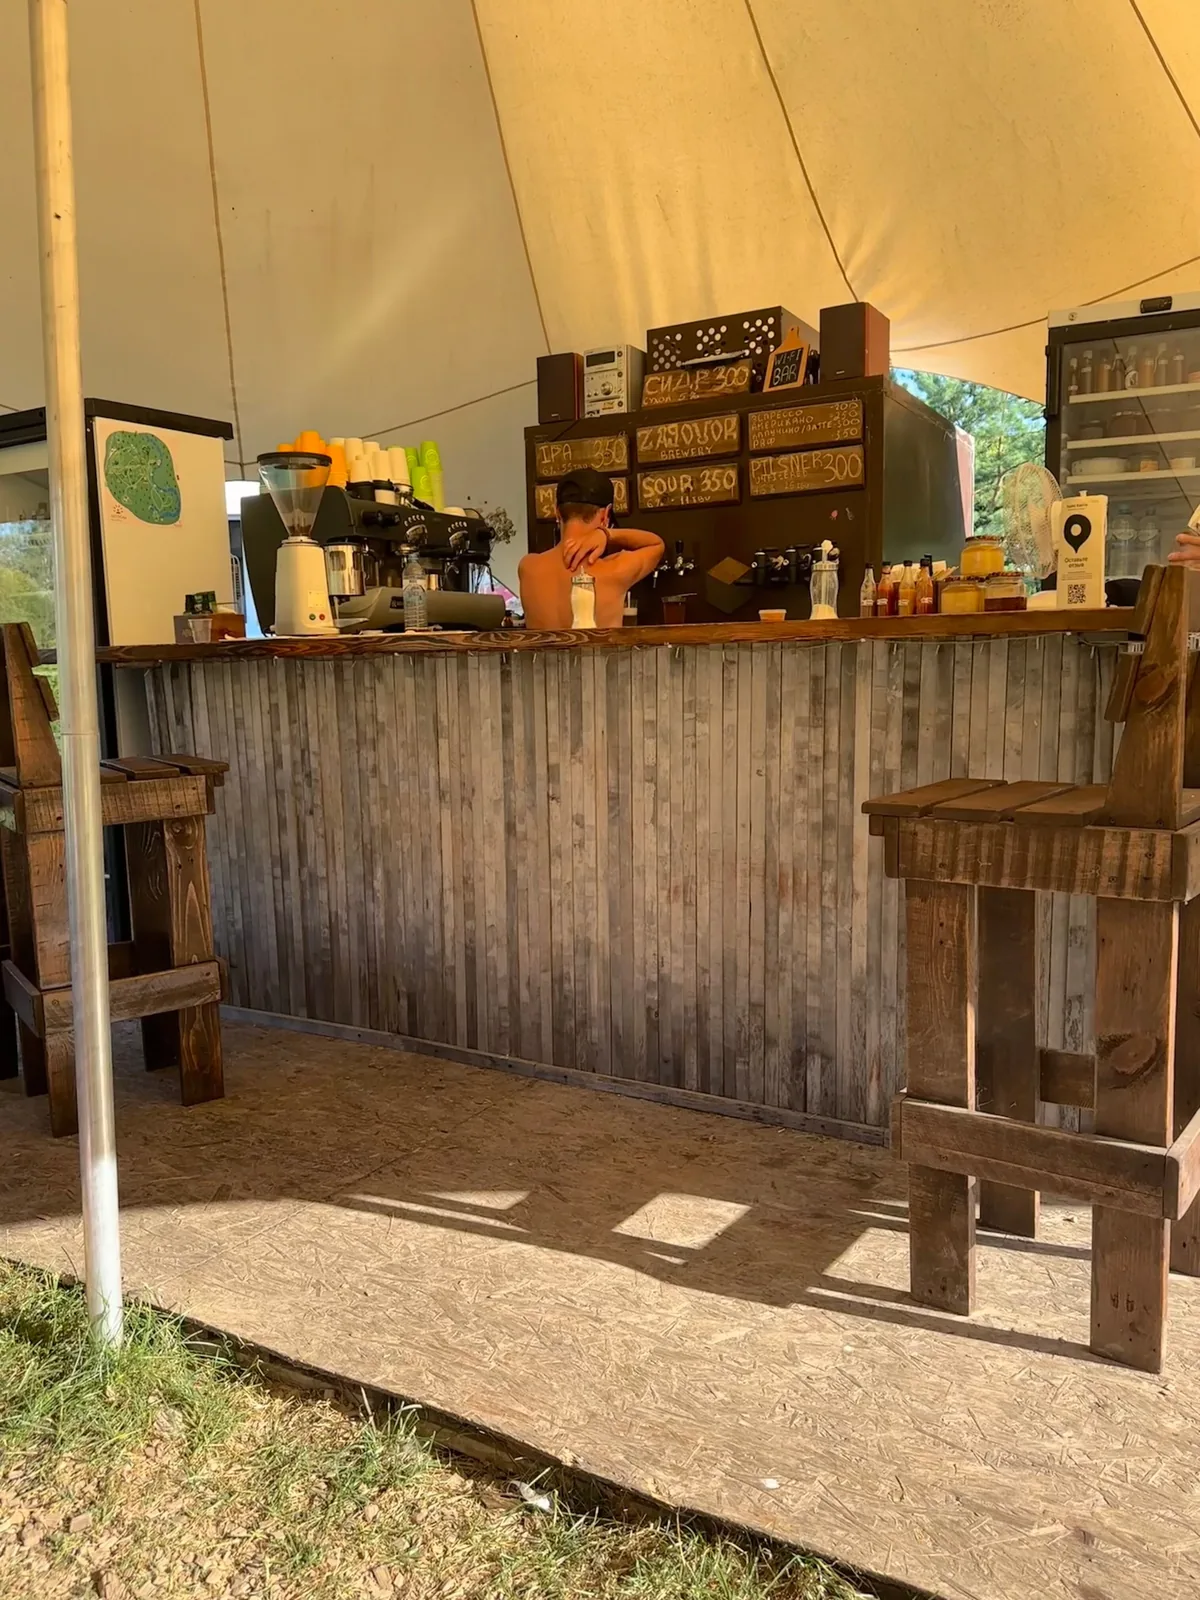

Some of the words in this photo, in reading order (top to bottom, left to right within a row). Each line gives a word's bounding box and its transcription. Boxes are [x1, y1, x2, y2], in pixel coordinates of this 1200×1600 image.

[711, 365, 750, 391] 300
[773, 363, 797, 386] BAR
[752, 410, 804, 421] ЭСПРЕССО
[752, 416, 814, 430] АМЕРИКАНО
[540, 443, 572, 464] IPA
[591, 438, 627, 469] 350
[660, 446, 712, 460] BREWERY
[753, 437, 776, 448] РАФ
[751, 451, 823, 479] PILSNER
[823, 453, 862, 482] 300
[642, 474, 694, 498] SOUR
[700, 469, 736, 492] 350
